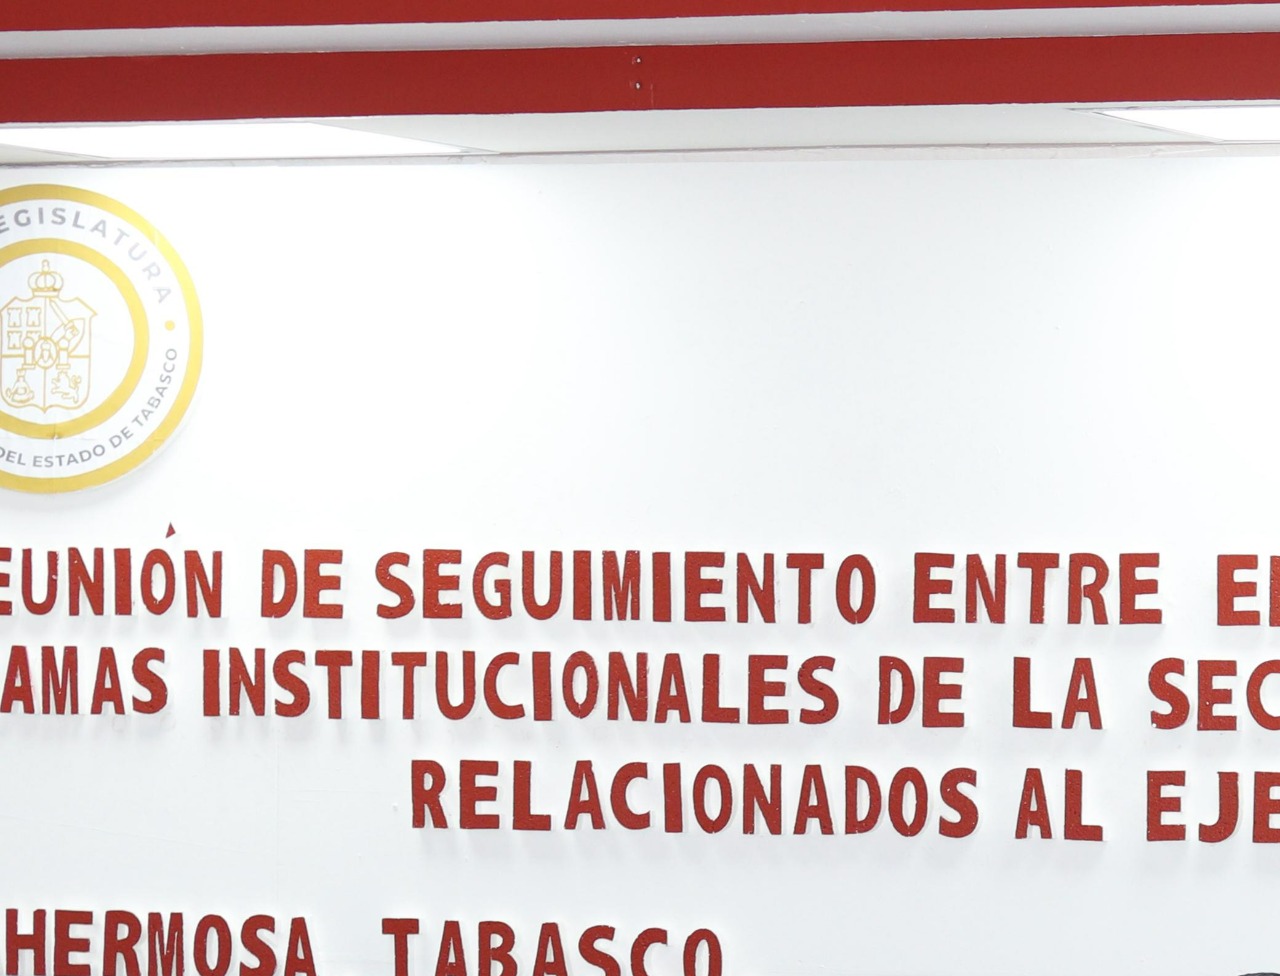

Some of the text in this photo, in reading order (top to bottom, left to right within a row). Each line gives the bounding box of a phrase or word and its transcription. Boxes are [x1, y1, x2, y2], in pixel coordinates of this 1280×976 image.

[33, 444, 106, 467] ESTADO
[109, 427, 134, 448] DE
[132, 348, 178, 428] TABASCO
[261, 549, 343, 619] DE
[375, 548, 875, 624] SEGUIMIENTO
[913, 552, 1163, 625] ENTRE
[203, 647, 838, 725] INSTITUCIONALES
[878, 655, 964, 728] DE
[1013, 657, 1102, 730] LA
[411, 759, 978, 838] RELACIONADOS
[1015, 767, 1103, 842] AL
